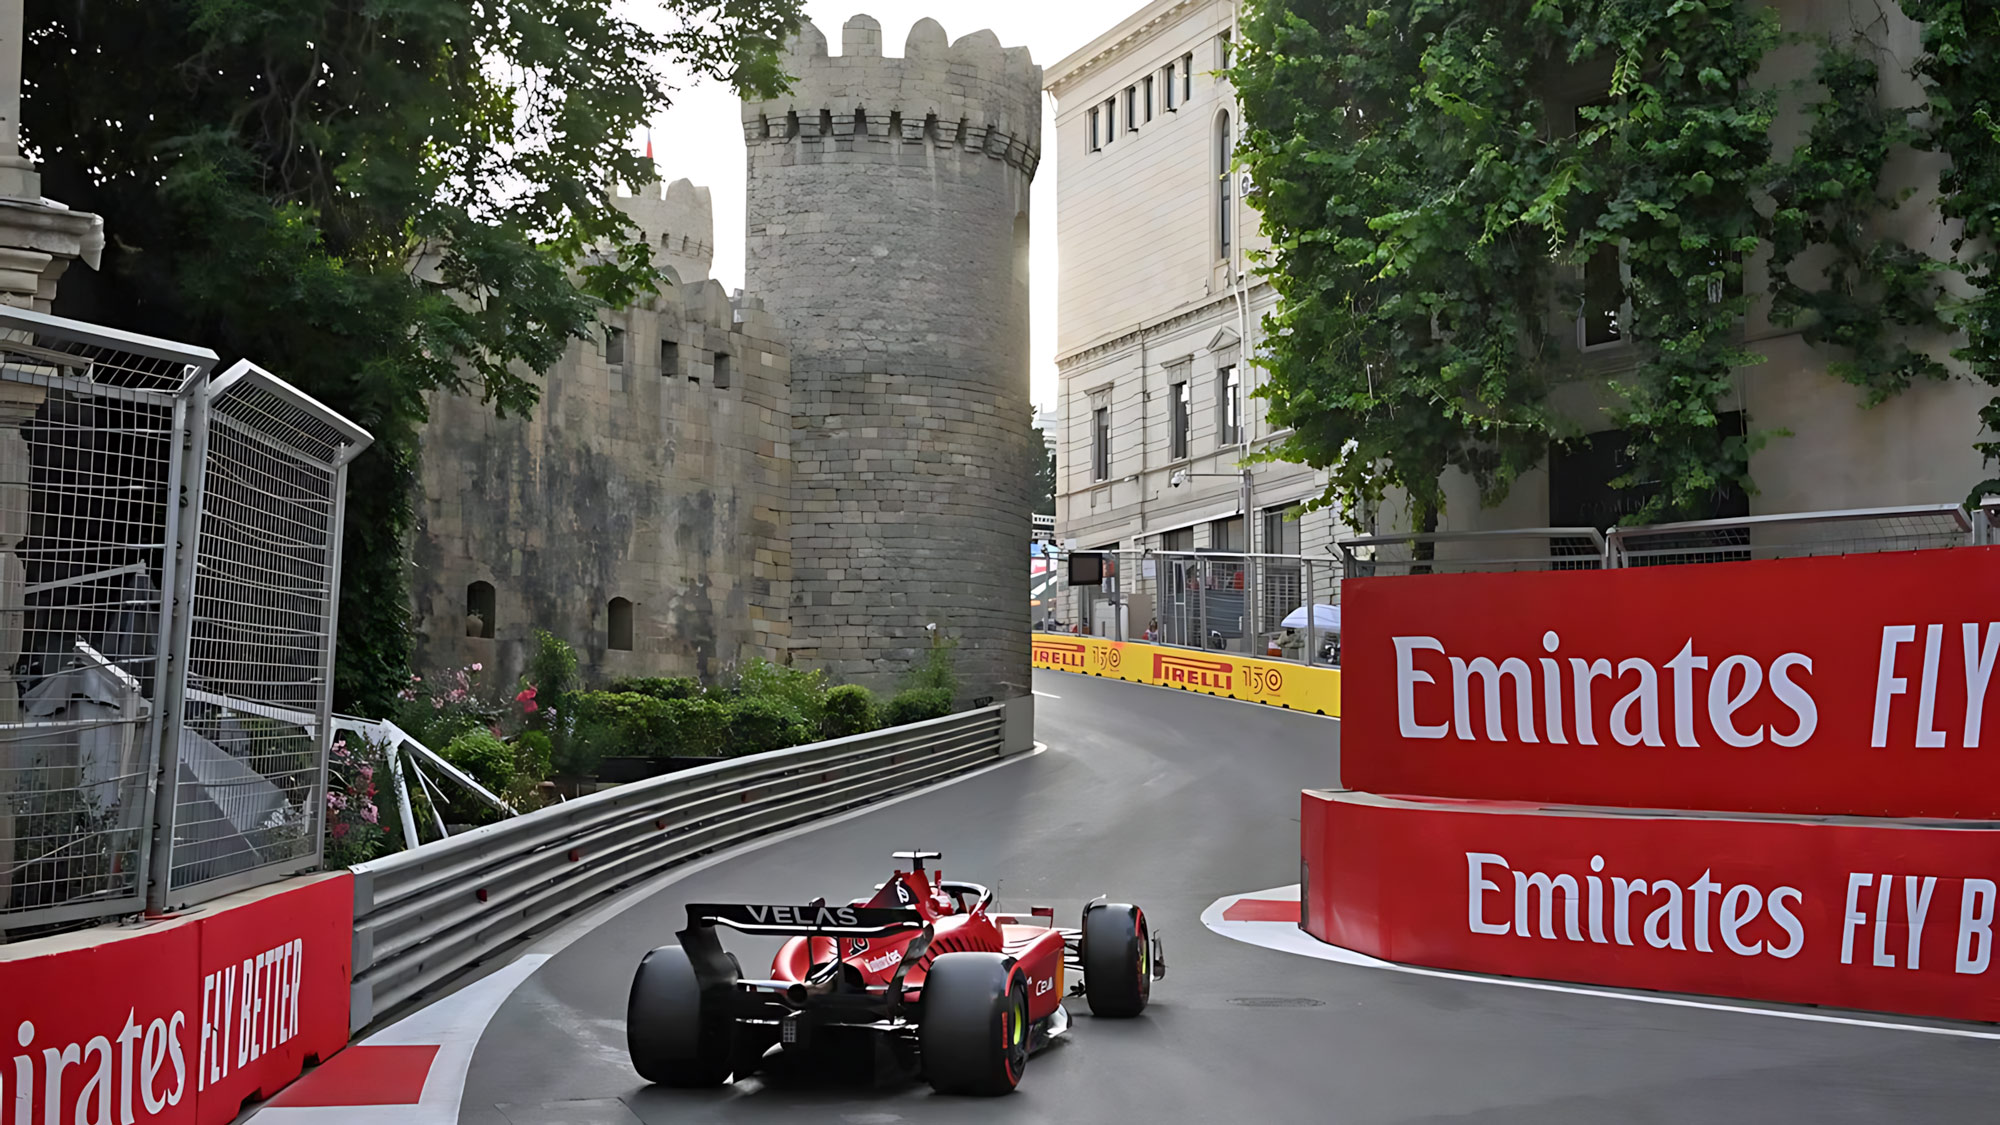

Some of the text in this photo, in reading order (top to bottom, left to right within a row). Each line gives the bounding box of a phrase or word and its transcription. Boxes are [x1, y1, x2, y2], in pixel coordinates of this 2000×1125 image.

[1153, 653, 1233, 690] PIRELLI
[1392, 622, 2000, 748] Emirates FLY
[745, 905, 858, 925] VELAS
[1466, 852, 1803, 958] Emirates
[1841, 872, 1937, 970] FLY
[0, 938, 302, 1125] irates FLY BETTER
